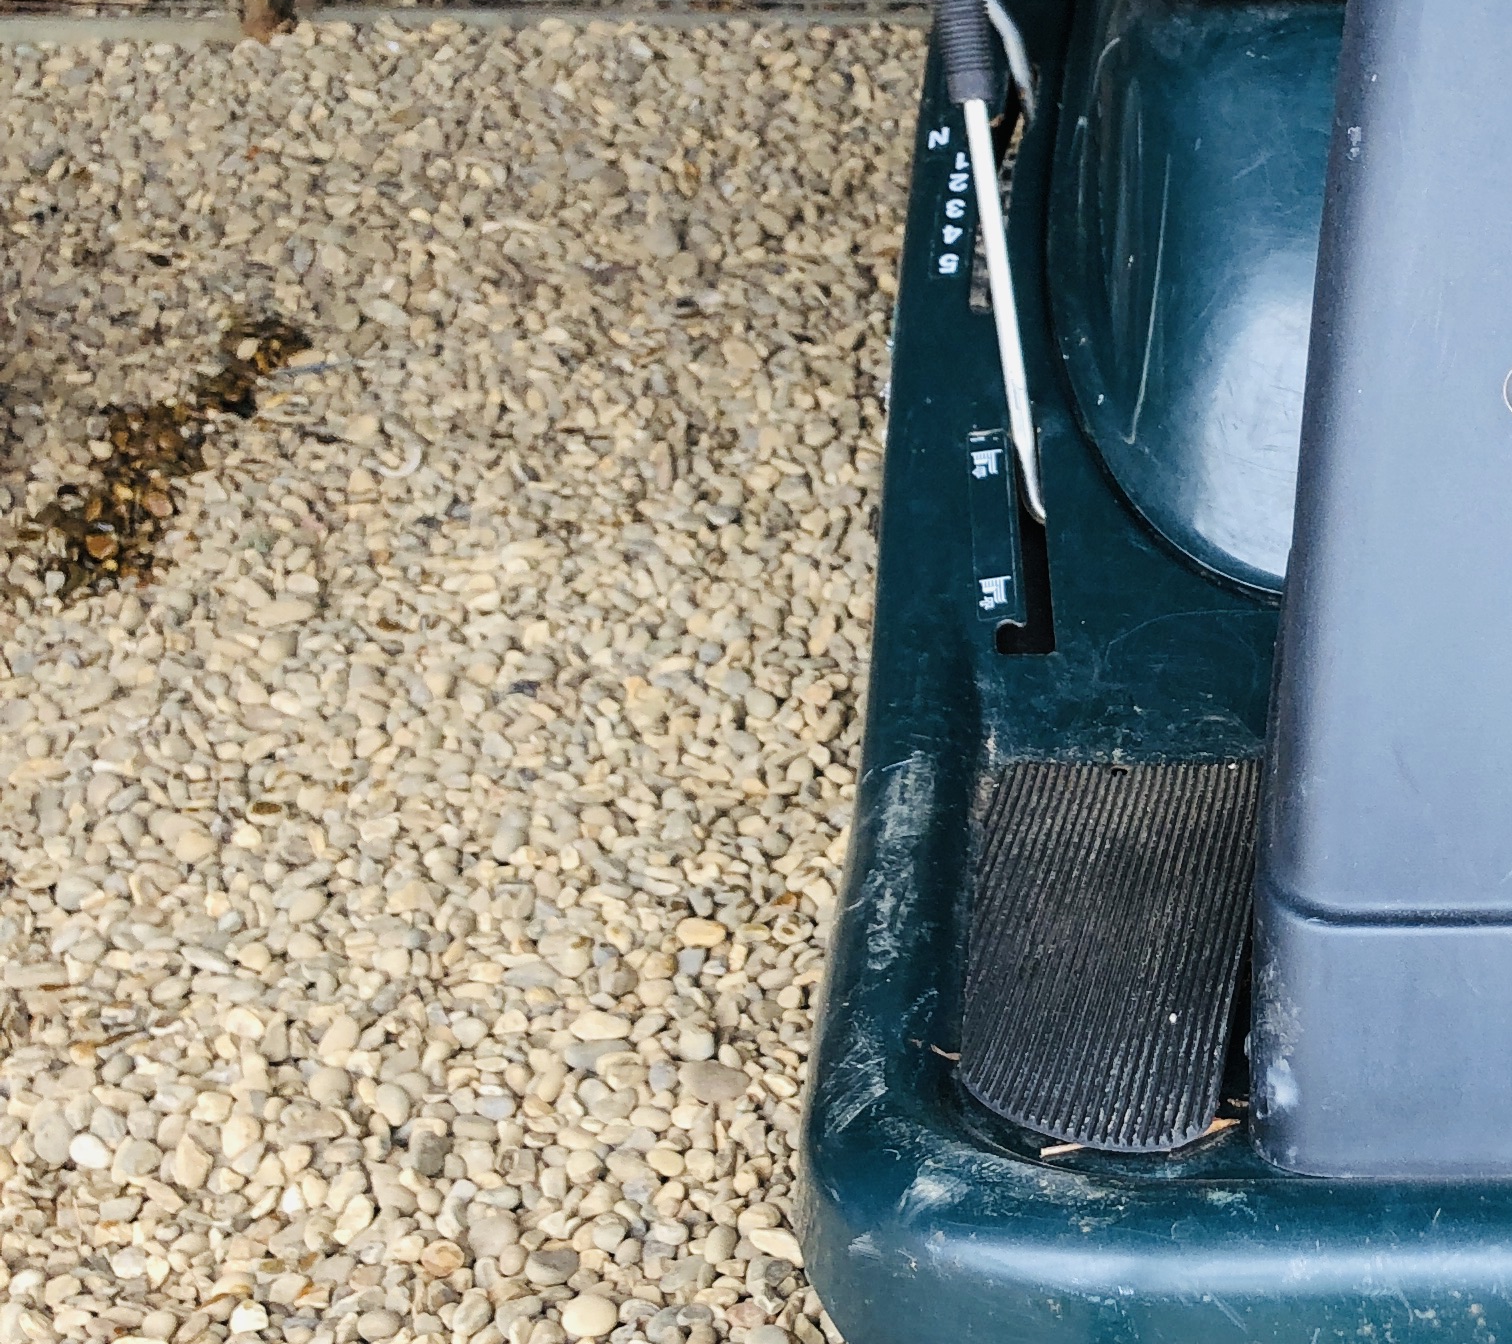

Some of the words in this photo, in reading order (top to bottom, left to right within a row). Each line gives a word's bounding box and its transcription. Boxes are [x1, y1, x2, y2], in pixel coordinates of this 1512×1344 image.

[948, 172, 970, 193] 2
[945, 198, 967, 219] 3
[941, 224, 964, 245] 4
[938, 253, 960, 275] 5
